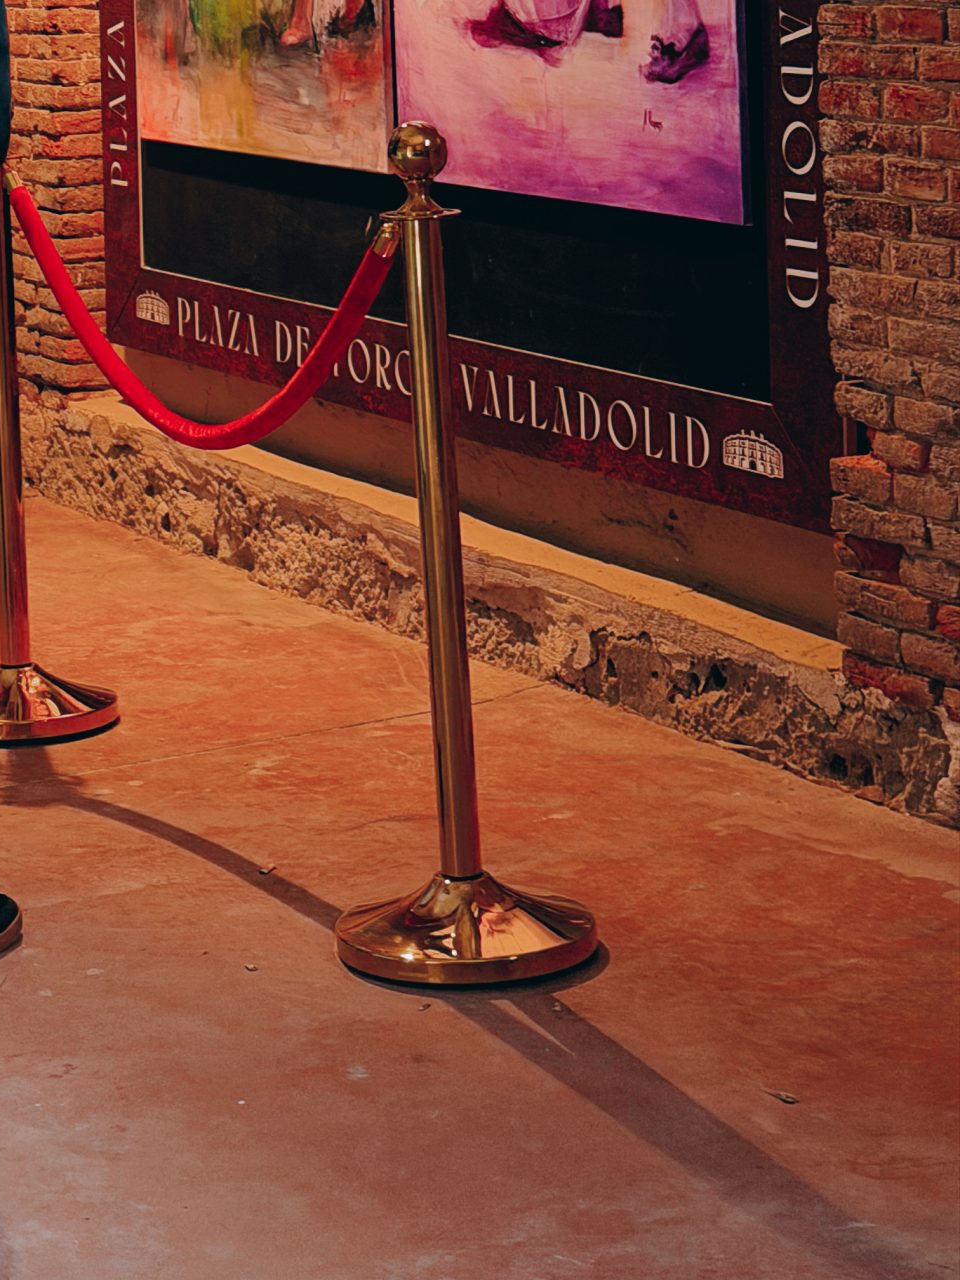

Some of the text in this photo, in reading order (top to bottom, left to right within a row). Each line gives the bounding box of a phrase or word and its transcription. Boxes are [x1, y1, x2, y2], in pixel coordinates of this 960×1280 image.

[107, 20, 129, 187] PLAZA
[176, 296, 260, 357] PLAZA
[274, 320, 311, 368] DE
[459, 362, 710, 469] VALLADOLID
